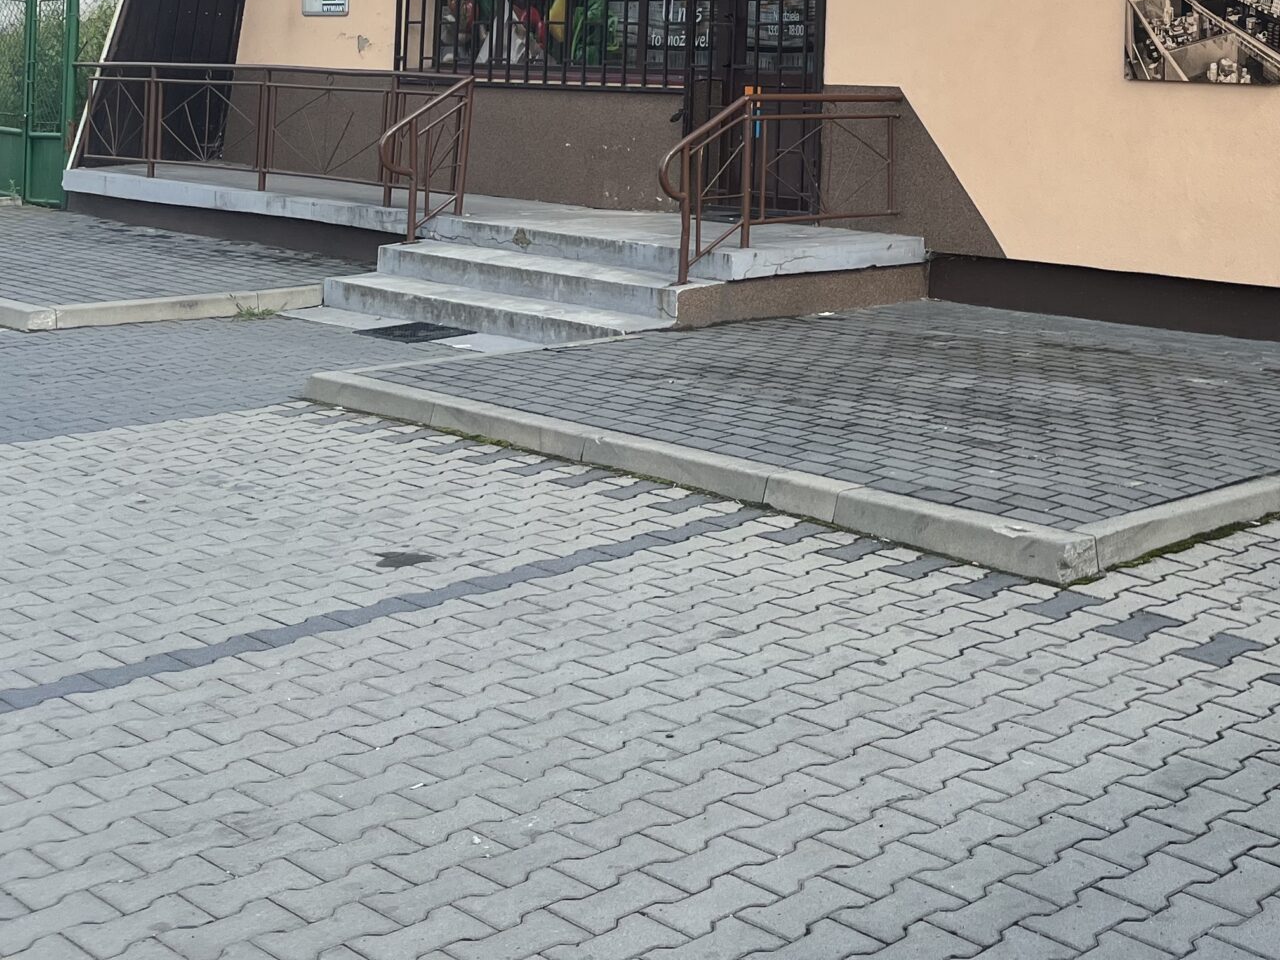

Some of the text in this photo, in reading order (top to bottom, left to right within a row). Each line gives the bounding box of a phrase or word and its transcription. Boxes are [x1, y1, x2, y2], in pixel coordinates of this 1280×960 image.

[677, 7, 703, 23] ns
[773, 11, 800, 21] Ndziela
[651, 29, 709, 48] to możwe!
